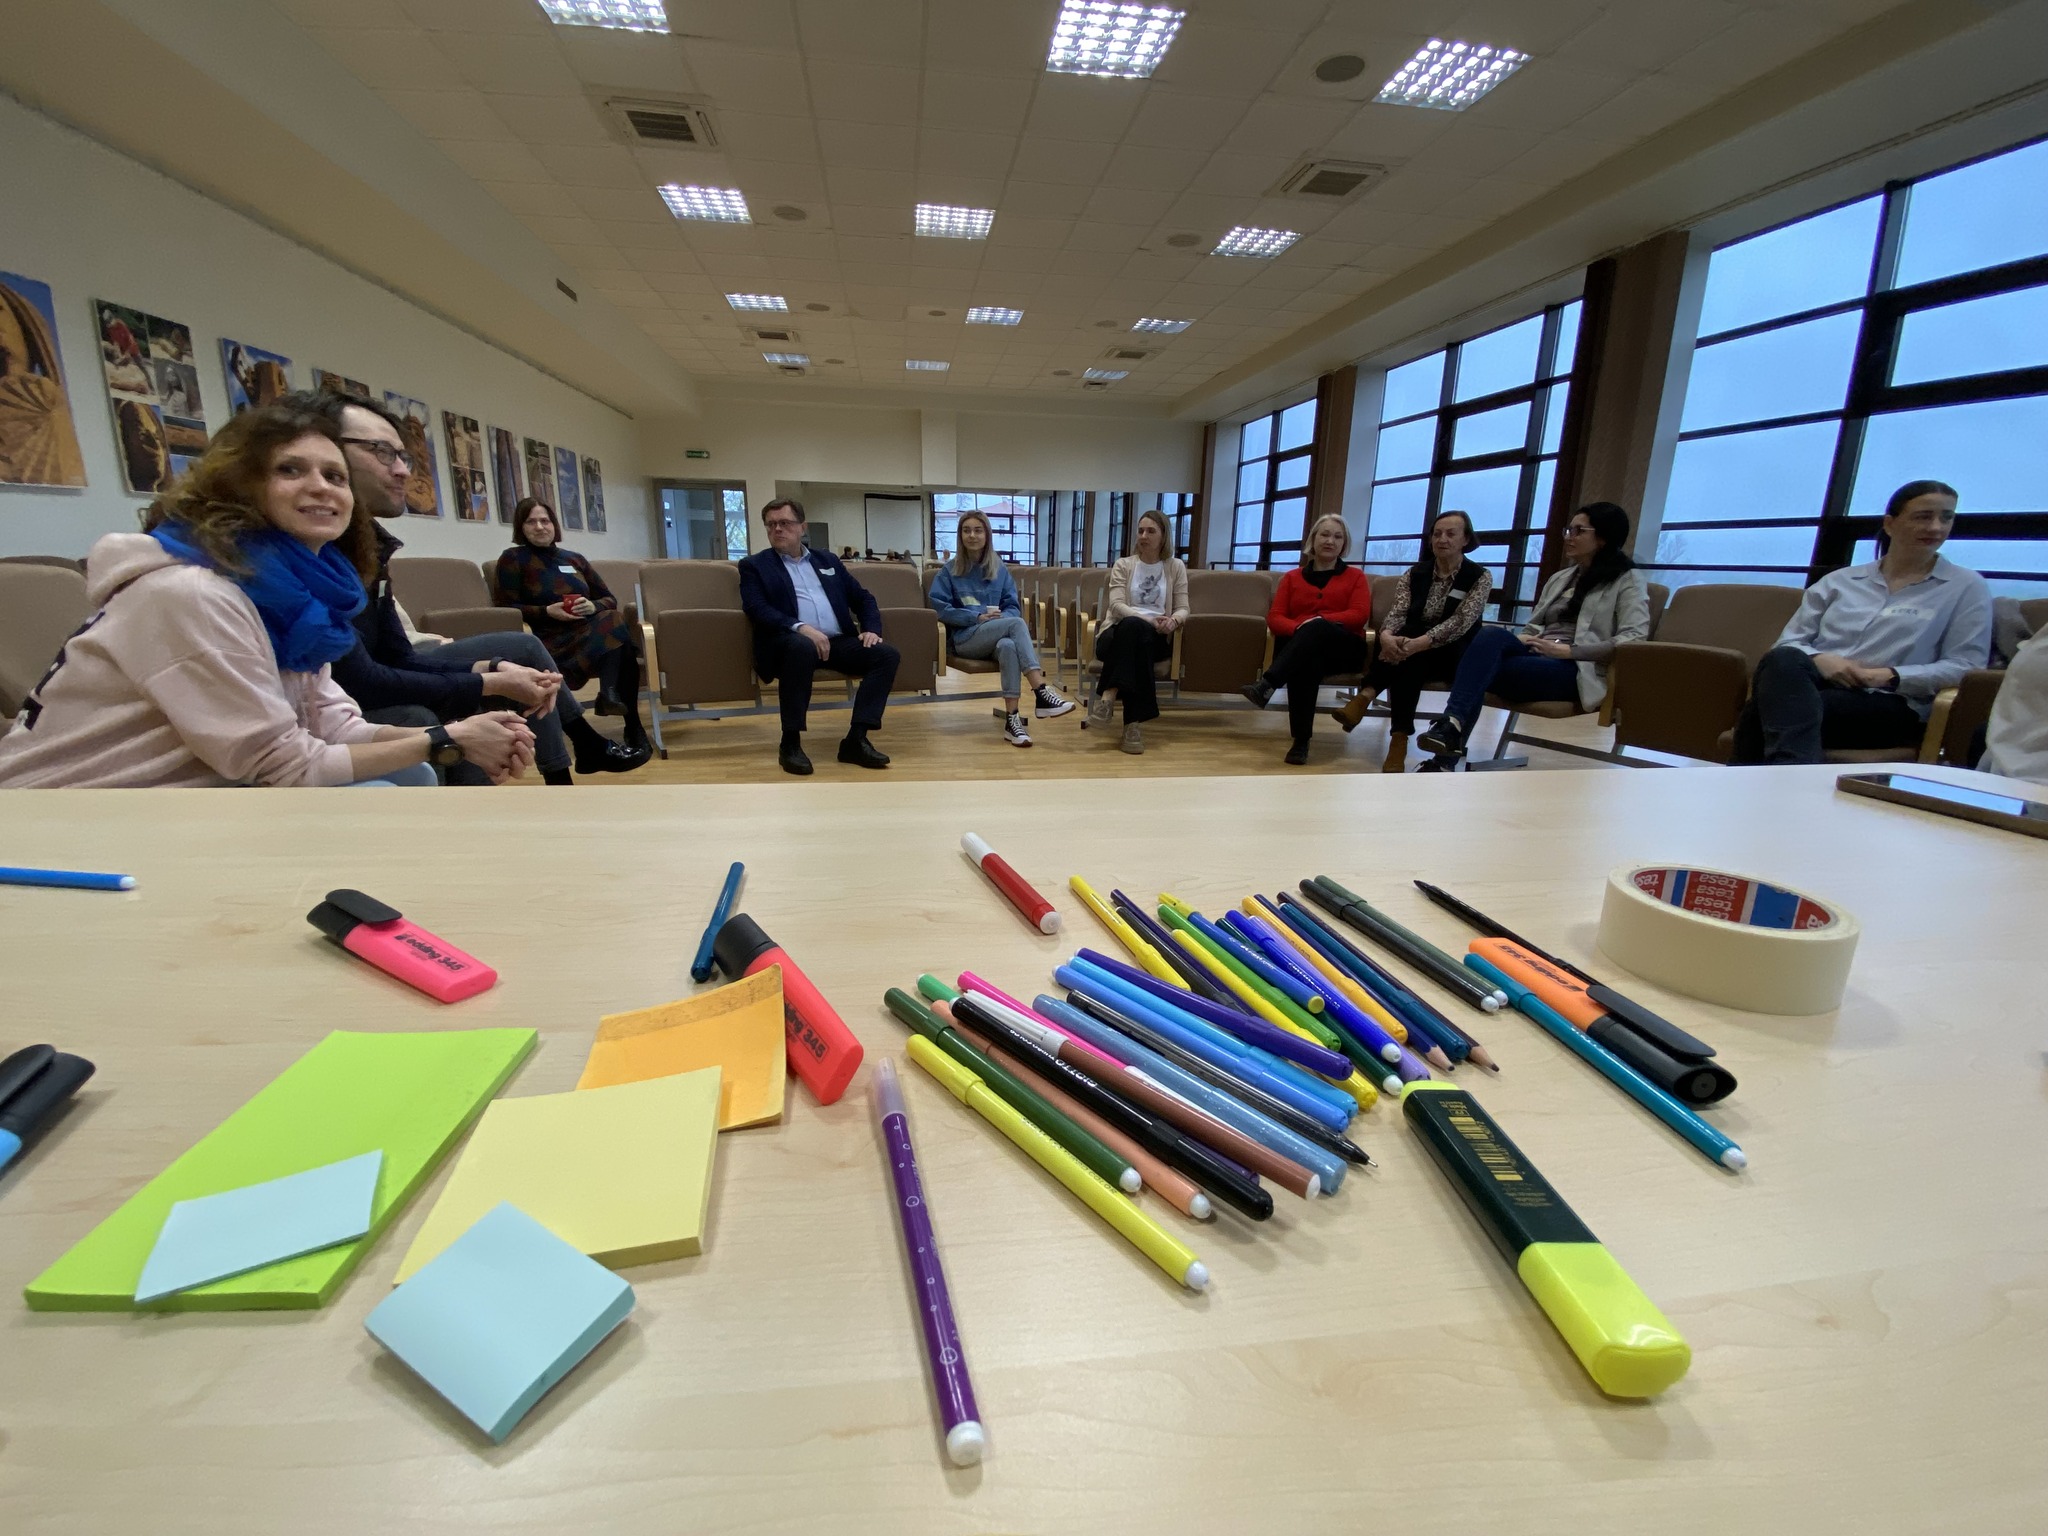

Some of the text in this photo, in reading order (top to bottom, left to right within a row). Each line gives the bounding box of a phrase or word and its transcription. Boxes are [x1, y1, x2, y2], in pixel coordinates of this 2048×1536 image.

[1696, 884, 1736, 898] tesa
[1700, 873, 1739, 889] tesa
[1695, 896, 1734, 912] tesa
[406, 938, 442, 960] edding
[438, 956, 464, 971] 345
[803, 1028, 826, 1058] 345
[1055, 1058, 1099, 1088] GIOTTO
